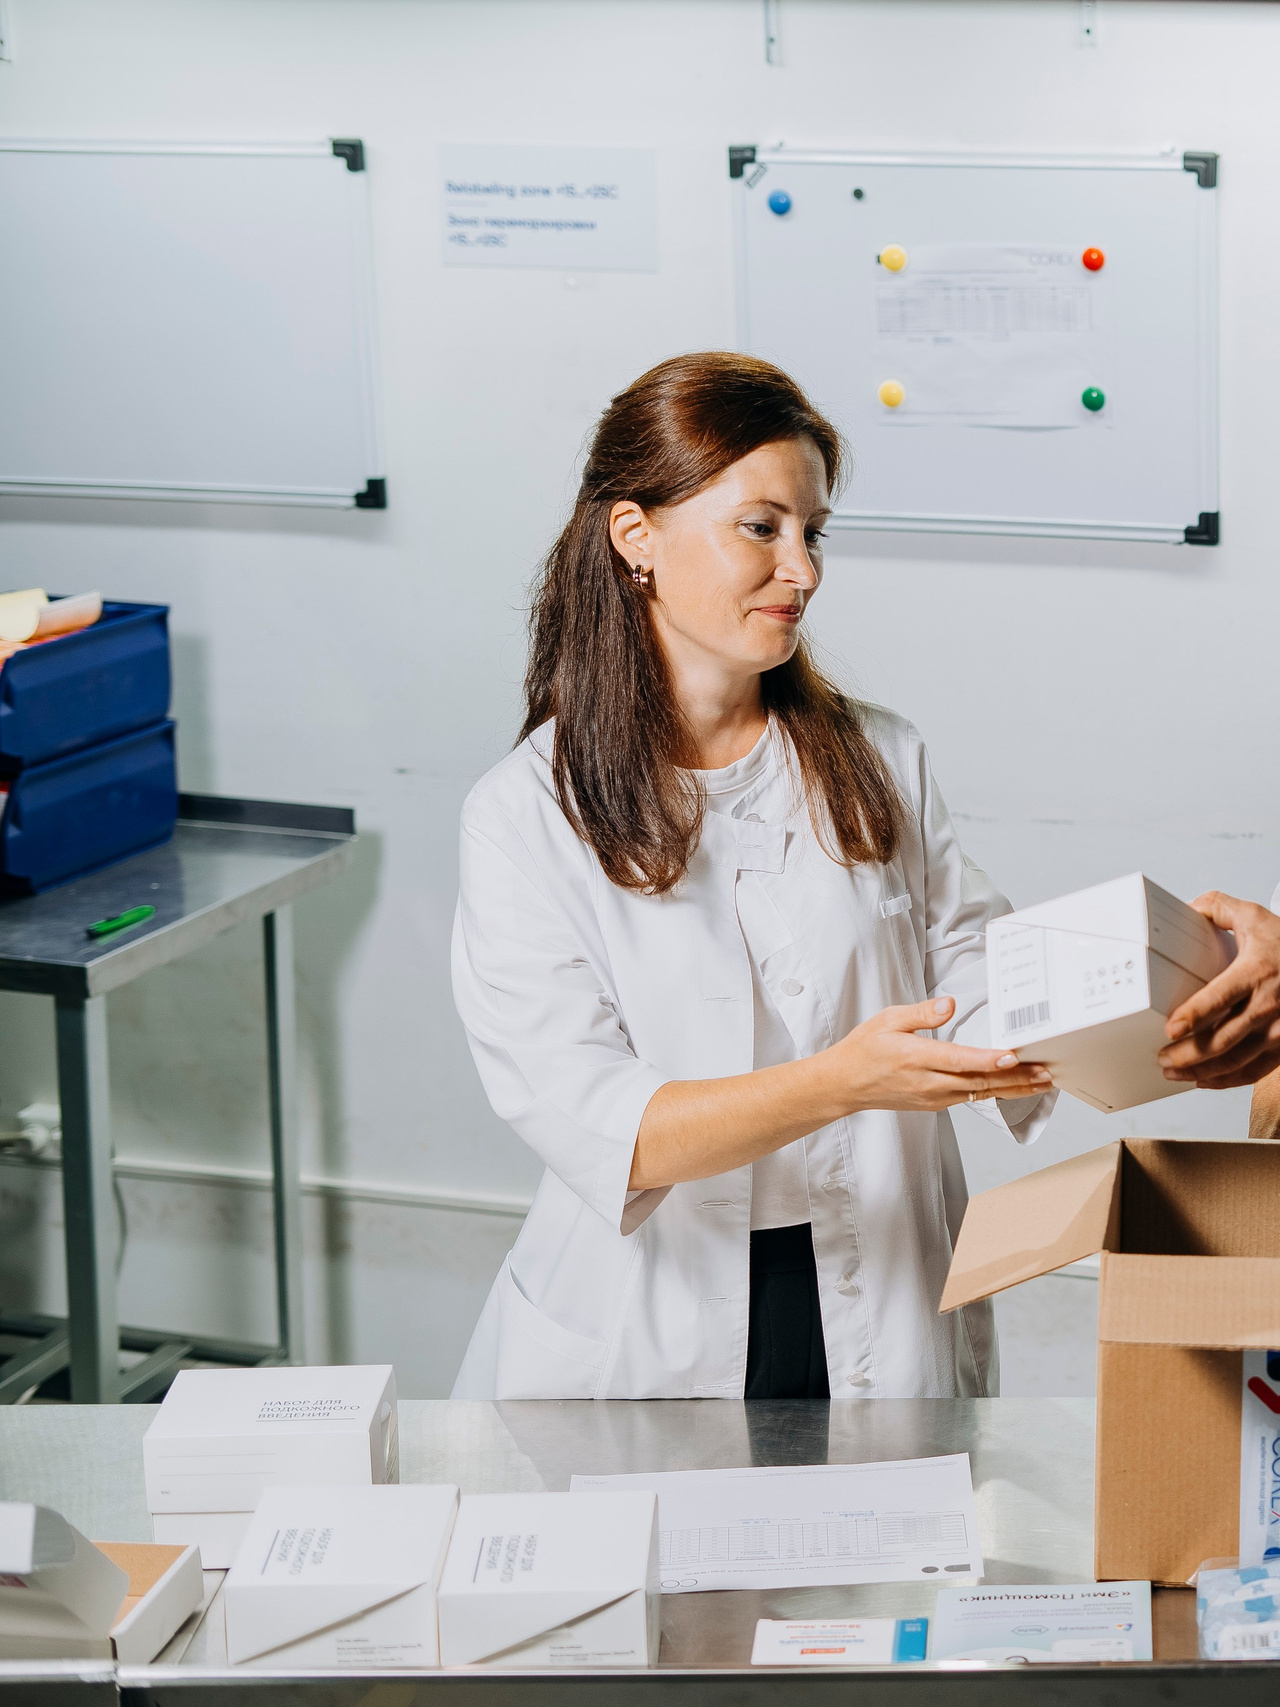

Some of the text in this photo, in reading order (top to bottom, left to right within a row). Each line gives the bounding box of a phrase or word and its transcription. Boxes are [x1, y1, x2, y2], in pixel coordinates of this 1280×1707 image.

[257, 1411, 331, 1419] ВВЕДЕНИЯ
[260, 1405, 361, 1413] ПОДКОЖНОГО
[1258, 1500, 1266, 1525] logistics
[277, 1529, 299, 1563] ВВЕДЕНИЯ
[289, 1528, 317, 1576] ПОДКОЖНОГО
[311, 1527, 335, 1565] НАБОР ДЛЯ
[524, 1534, 540, 1557] НАБОР
[500, 1535, 522, 1583] ПОДКОЖНОГО
[958, 1590, 1131, 1603] «Эми Помощник»
